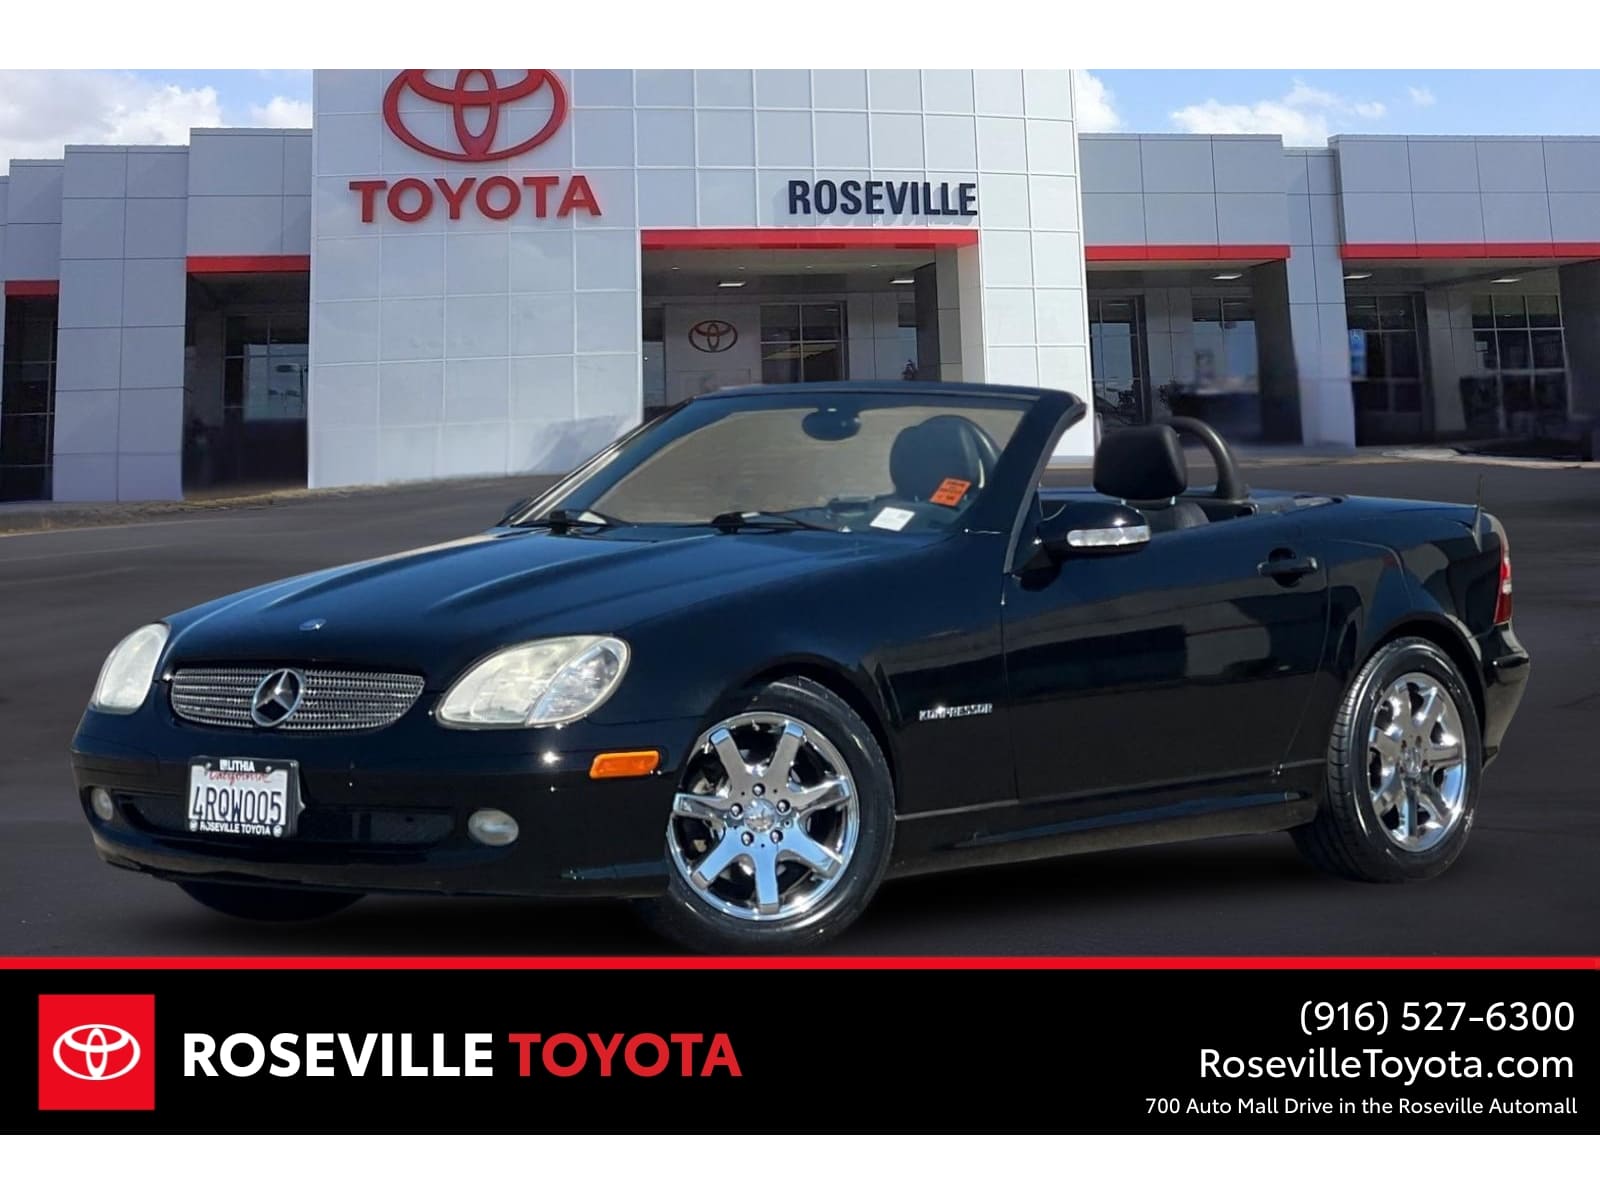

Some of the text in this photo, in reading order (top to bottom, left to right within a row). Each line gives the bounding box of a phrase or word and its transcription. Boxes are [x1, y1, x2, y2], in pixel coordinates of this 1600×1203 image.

[350, 175, 601, 223] TOYOTA
[788, 180, 978, 217] ROSEVILLE
[225, 760, 255, 772] LITHIA
[193, 786, 282, 823] 4RQW005
[200, 821, 271, 835] ROSEVILLE TOYOTA
